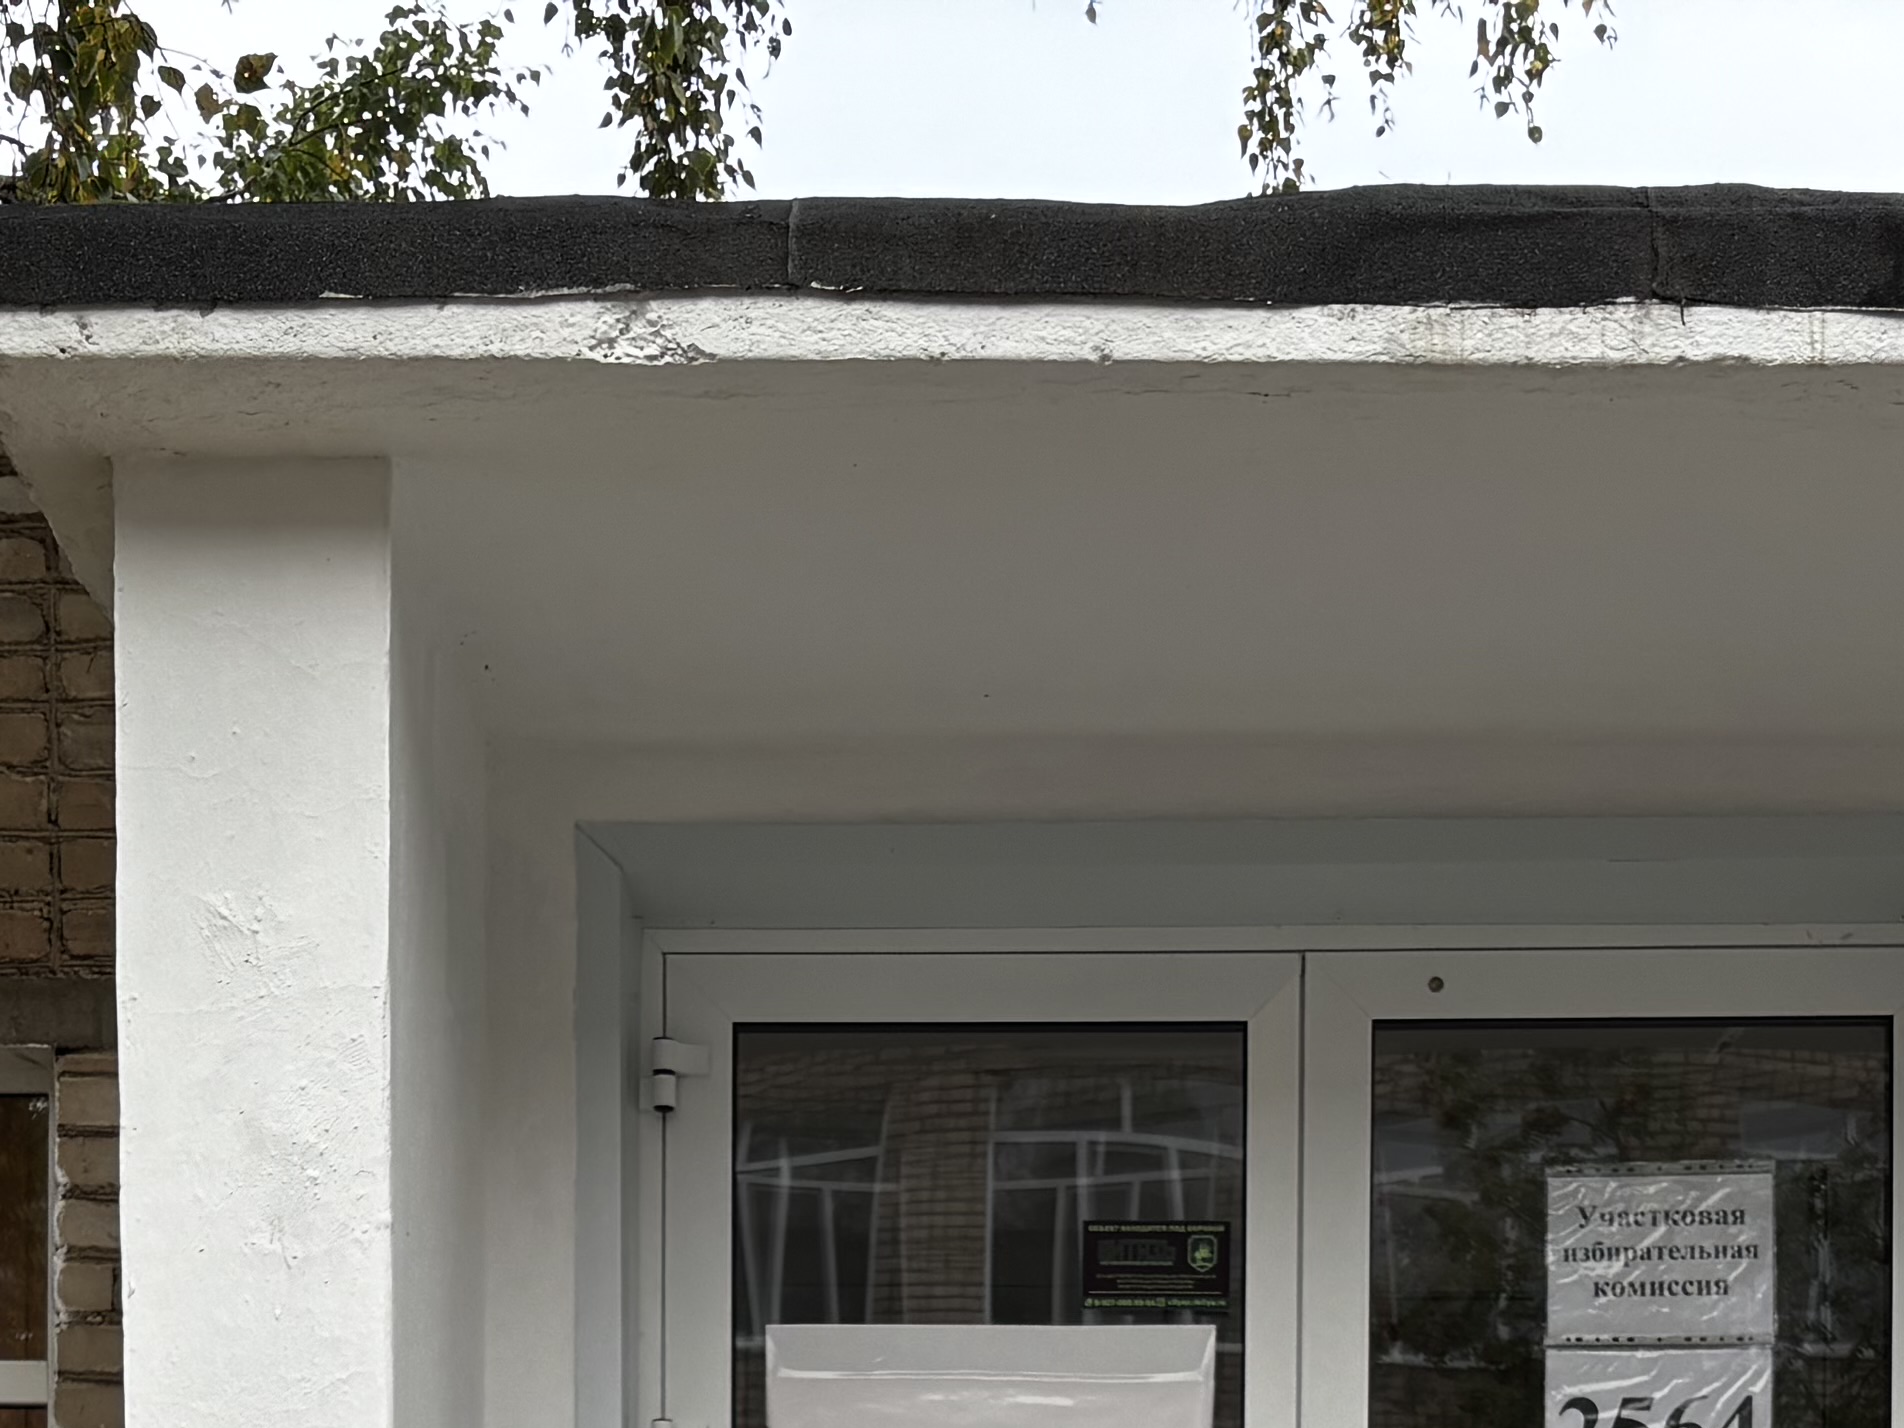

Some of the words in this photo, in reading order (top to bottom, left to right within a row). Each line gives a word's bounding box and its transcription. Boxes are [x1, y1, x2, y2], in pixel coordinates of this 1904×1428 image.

[1576, 1204, 1747, 1229] Участковая
[1563, 1241, 1759, 1267] избирательная
[1593, 1278, 1730, 1298] комиссия
